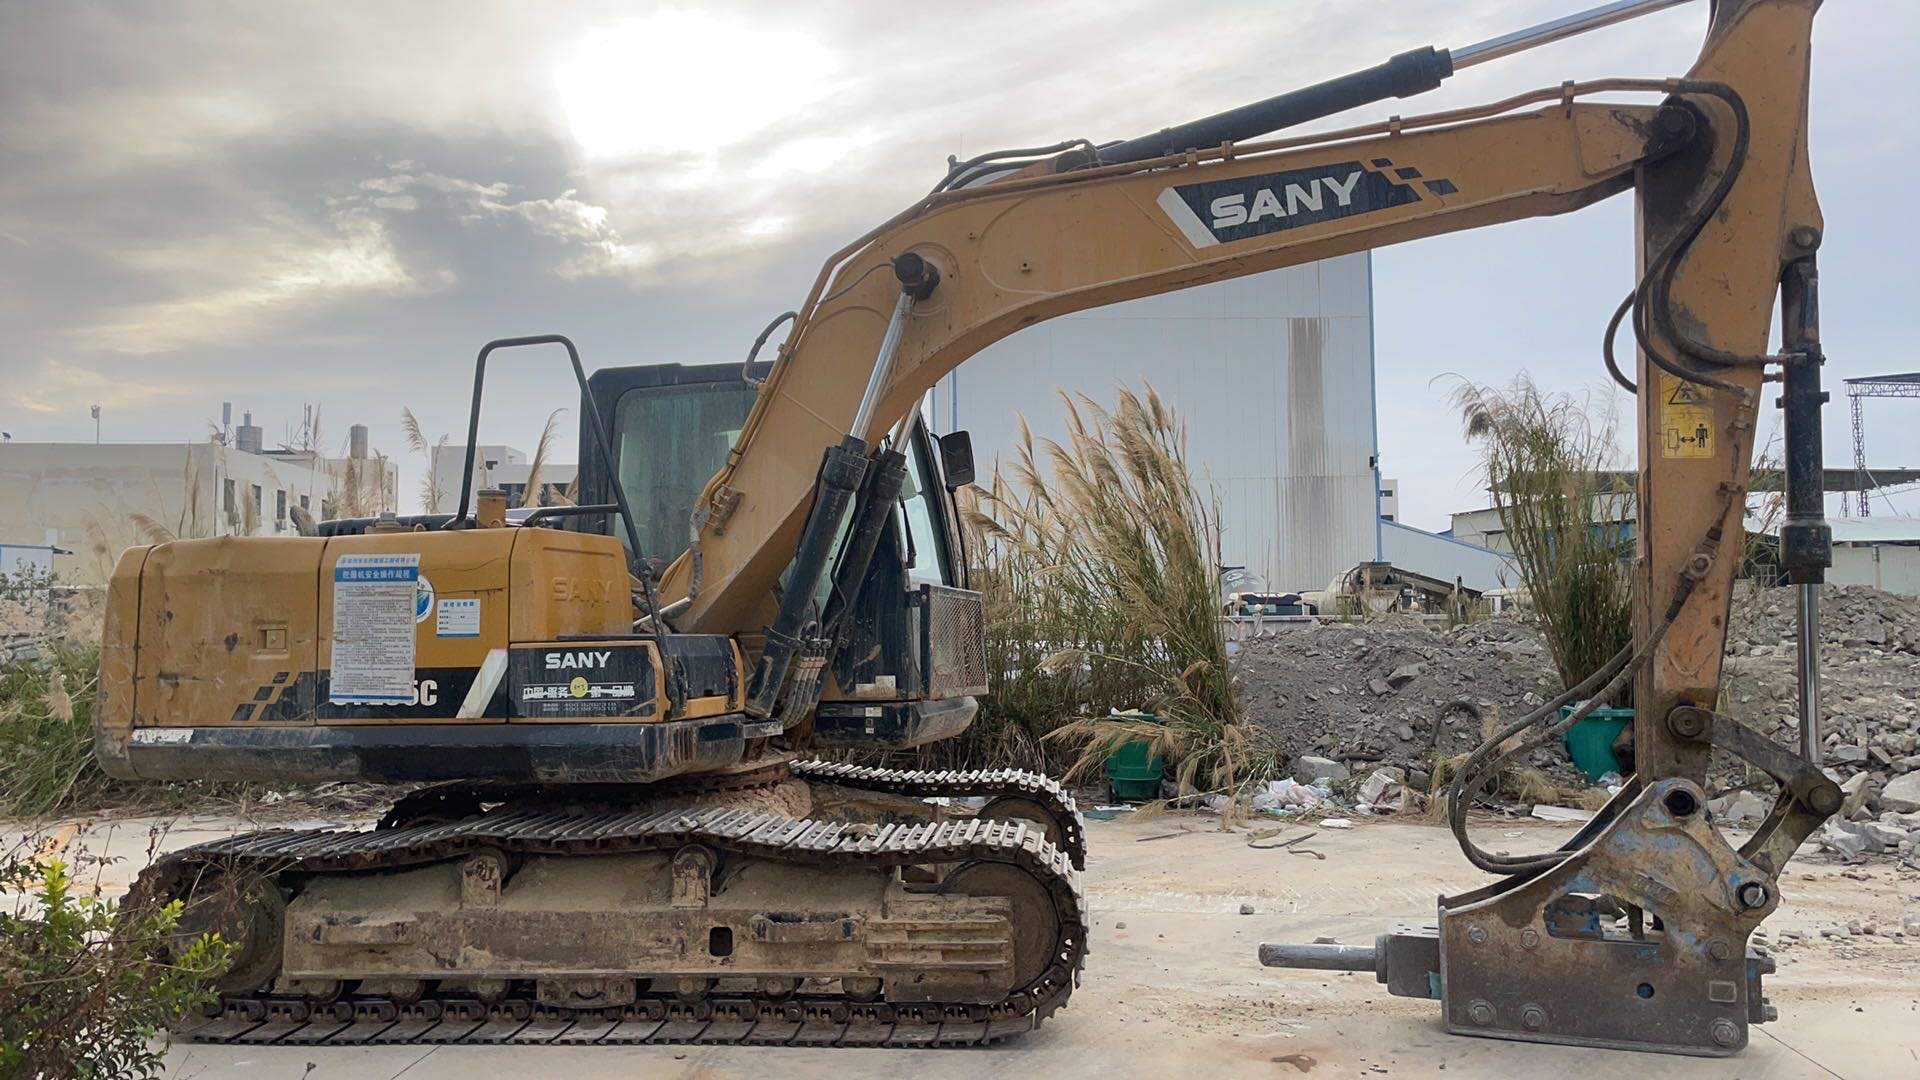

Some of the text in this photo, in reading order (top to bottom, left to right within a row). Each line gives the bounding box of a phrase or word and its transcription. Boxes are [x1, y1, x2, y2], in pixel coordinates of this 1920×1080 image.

[1210, 170, 1362, 229] SANY
[552, 576, 614, 603] SANY
[545, 651, 611, 669] SANY
